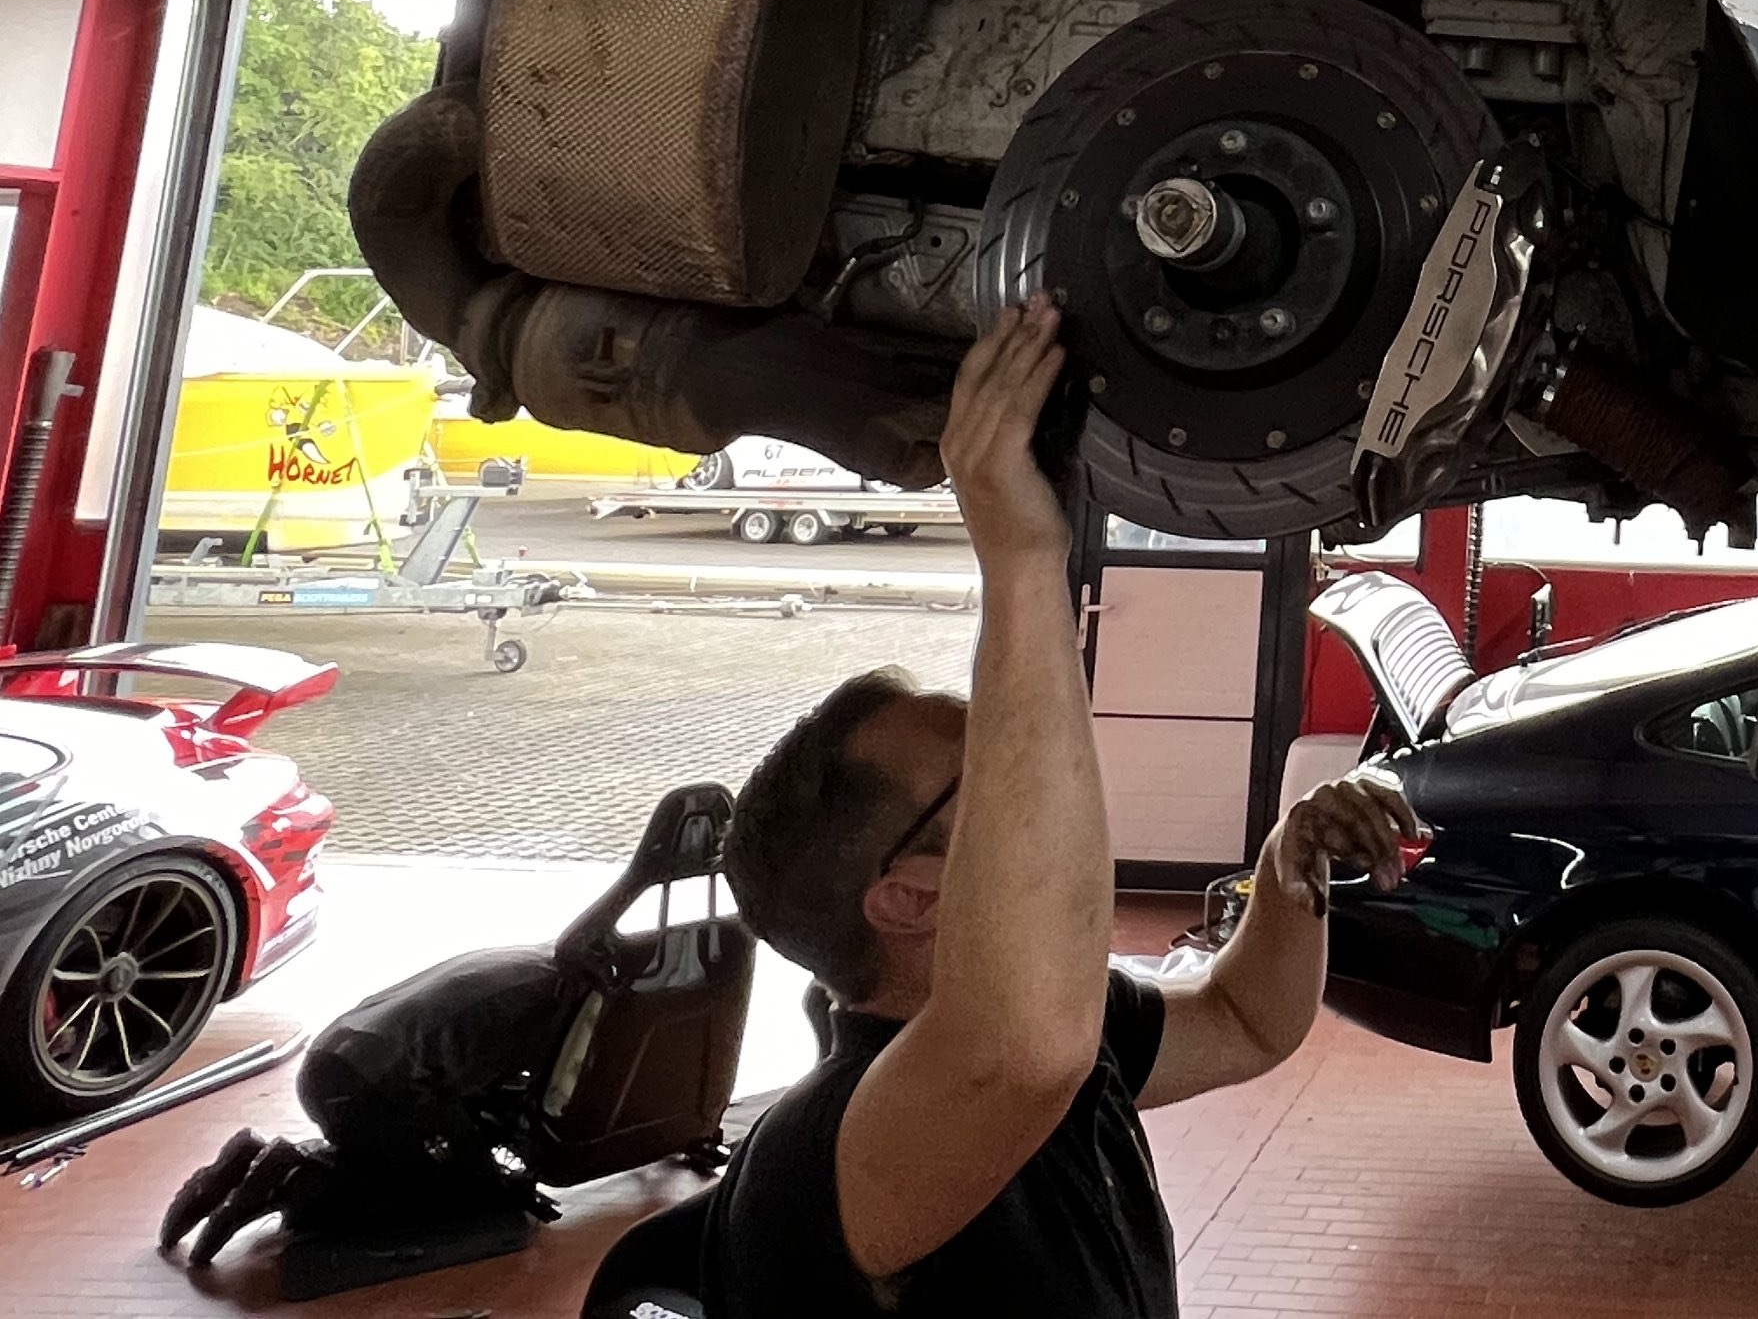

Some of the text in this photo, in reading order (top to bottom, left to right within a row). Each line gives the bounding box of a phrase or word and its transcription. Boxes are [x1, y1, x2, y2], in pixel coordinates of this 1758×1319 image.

[1378, 199, 1492, 447] PORSCHE
[268, 443, 355, 485] HORNET
[764, 444, 784, 460] 67
